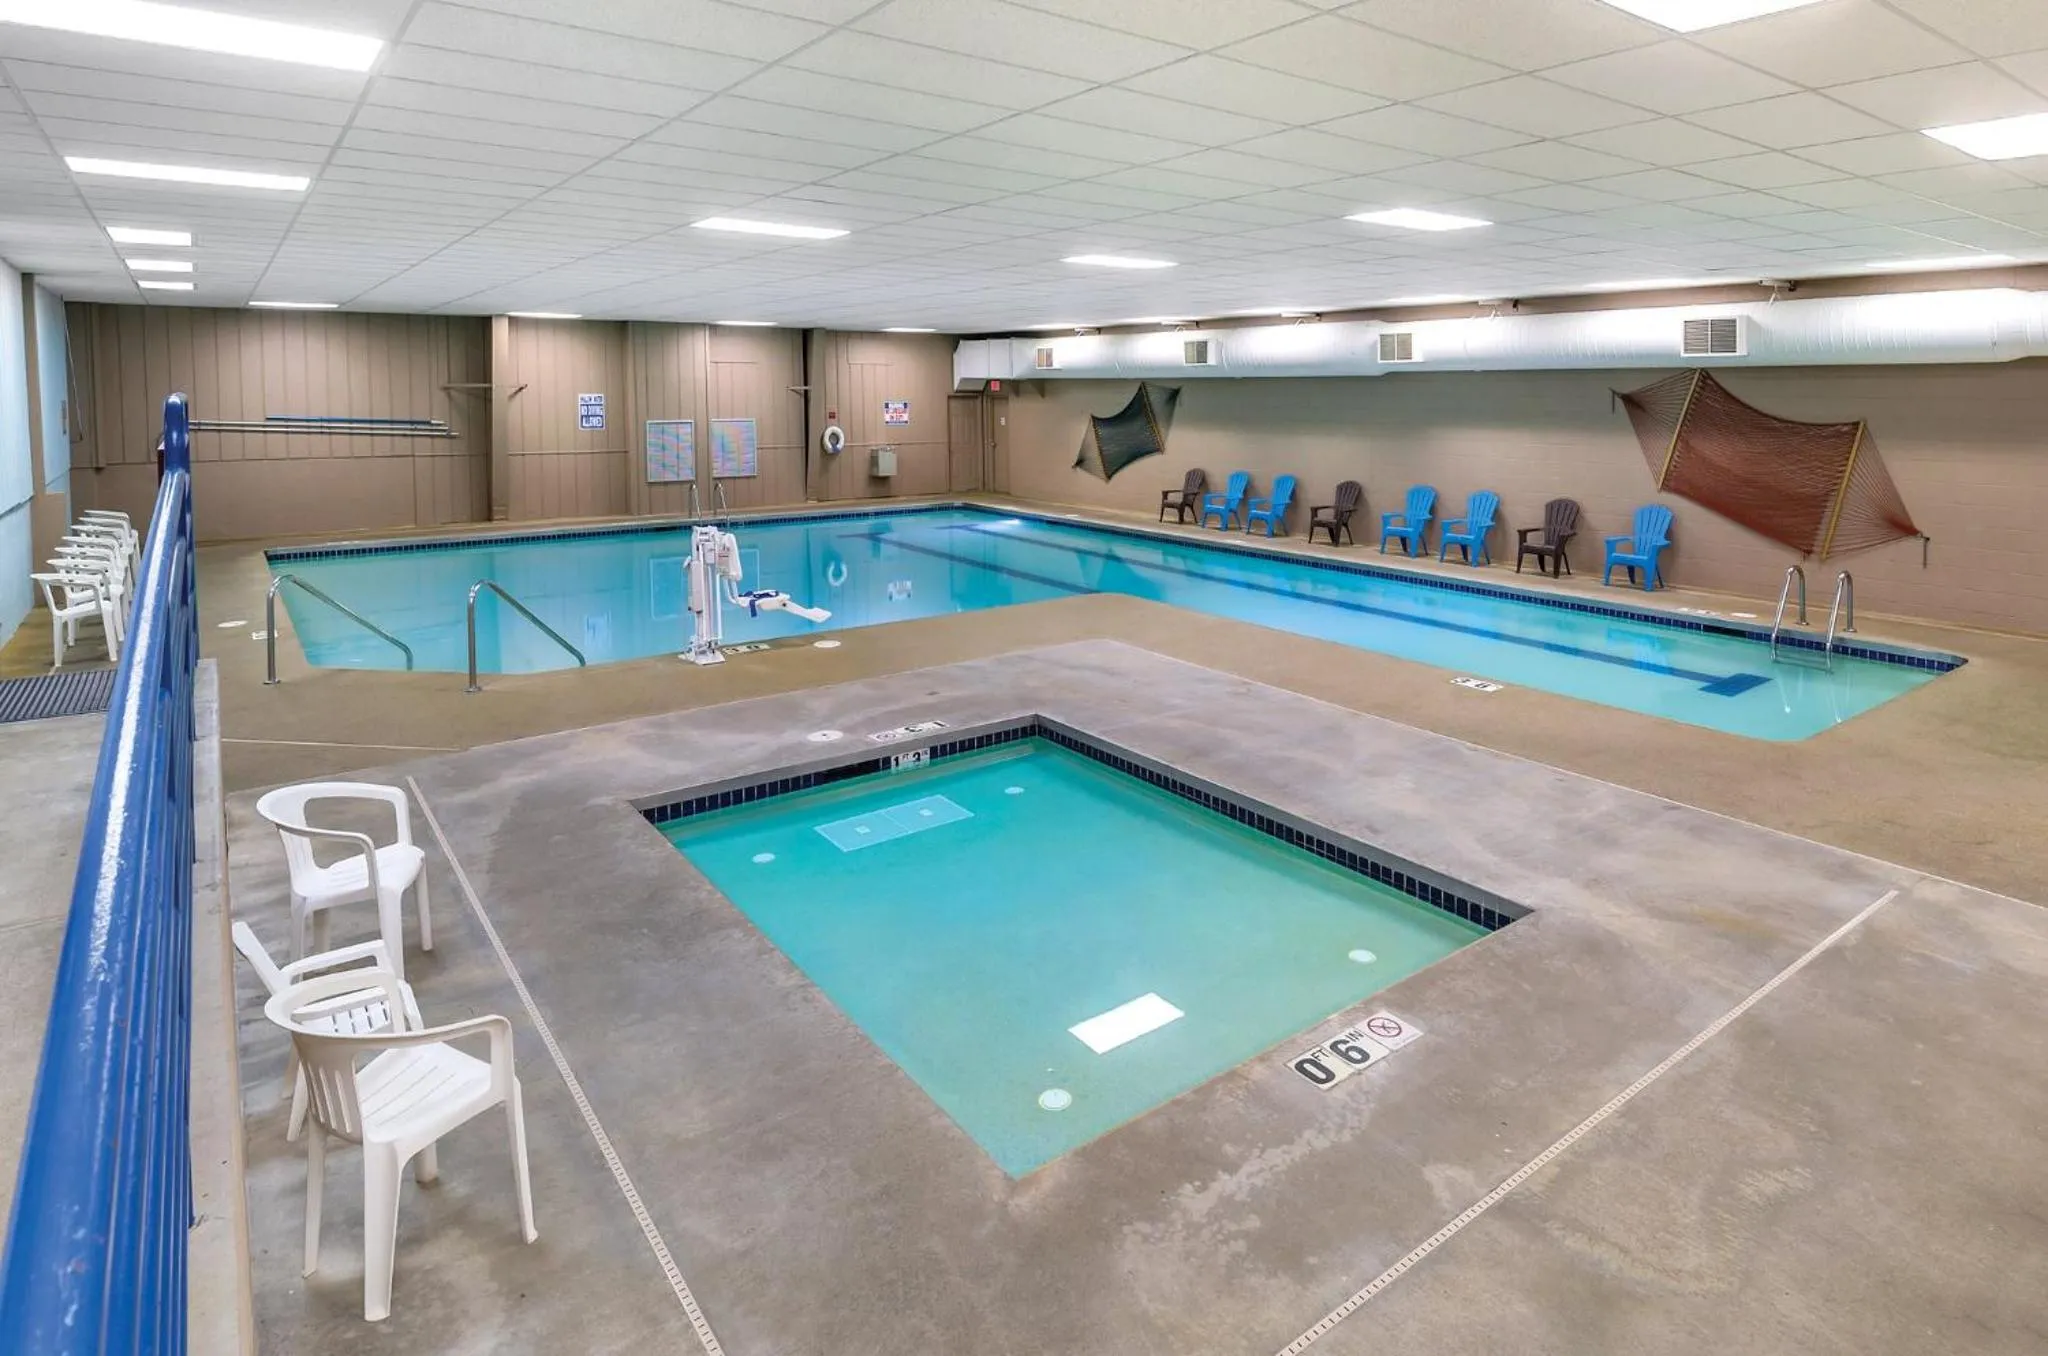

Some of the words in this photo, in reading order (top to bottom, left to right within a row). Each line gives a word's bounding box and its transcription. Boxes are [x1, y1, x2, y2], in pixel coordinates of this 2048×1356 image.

[1345, 1029, 1365, 1043] IN
[1311, 1048, 1330, 1062] FT
[1329, 1038, 1370, 1064] 6
[1294, 1058, 1336, 1084] 0
